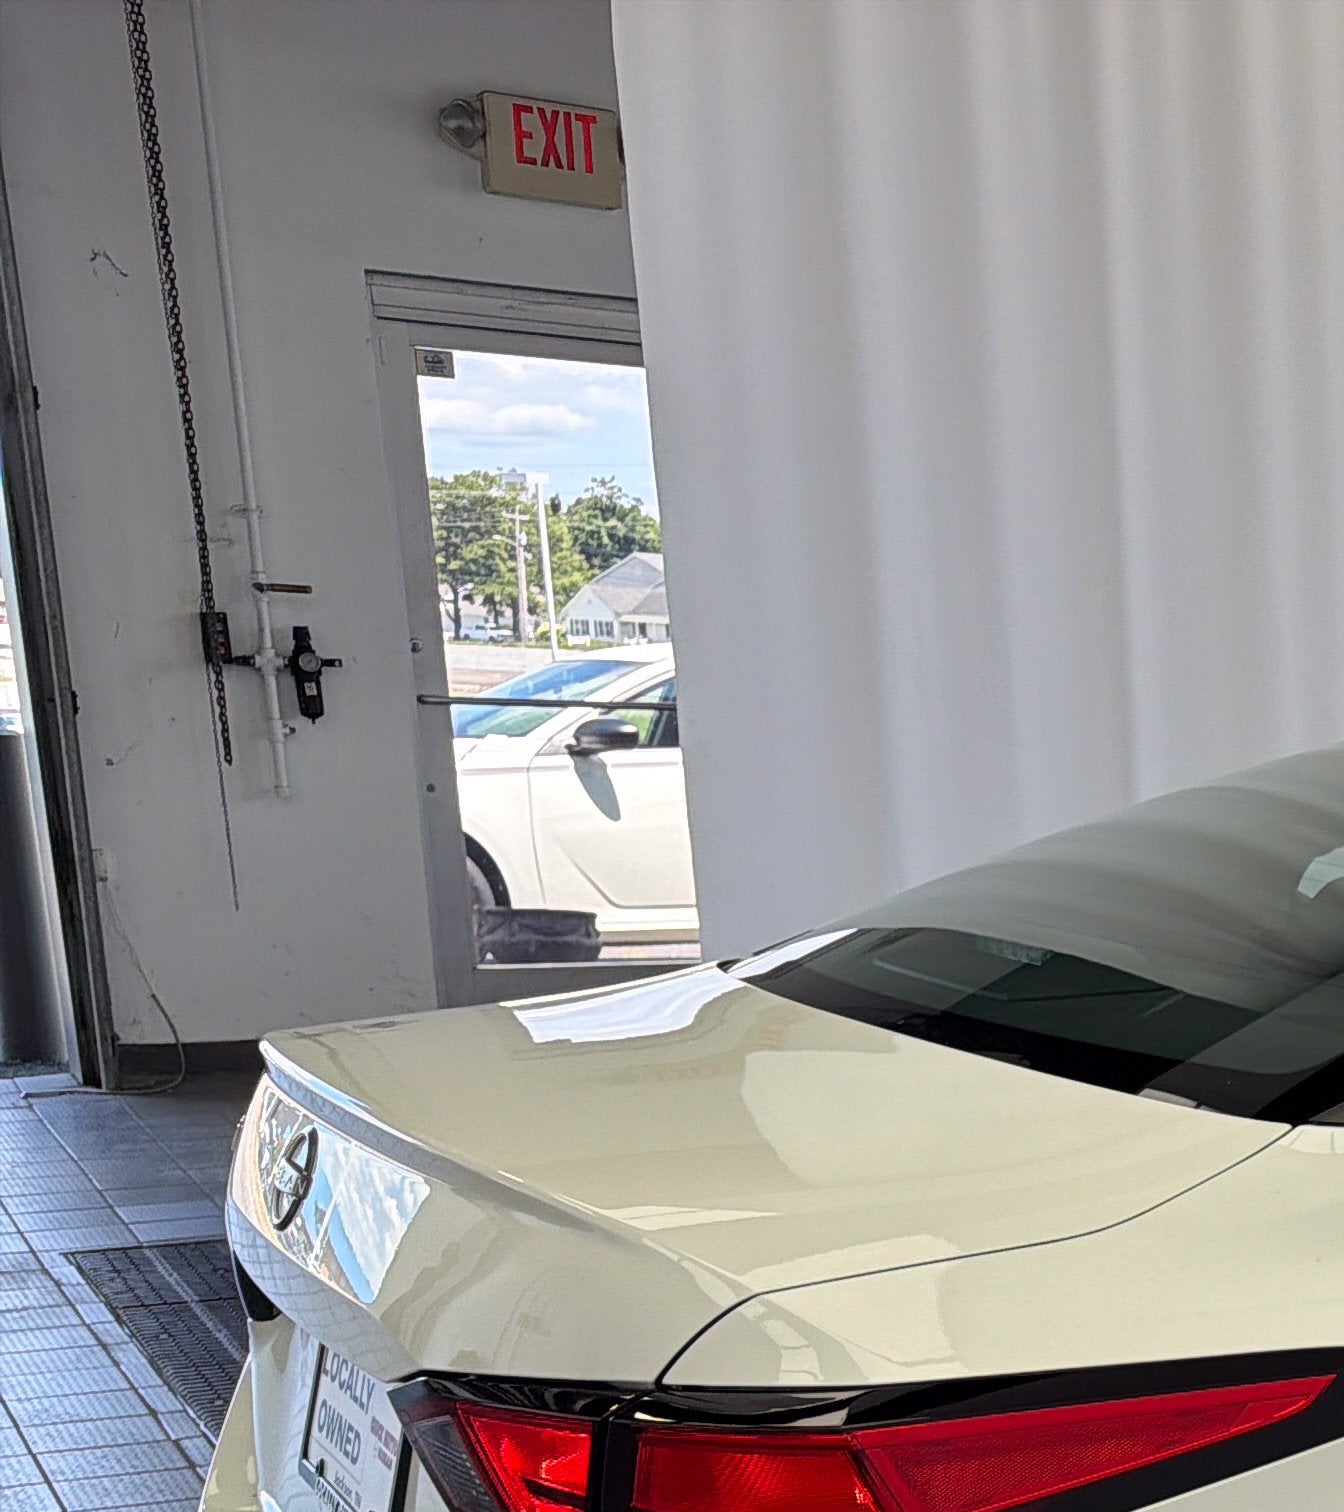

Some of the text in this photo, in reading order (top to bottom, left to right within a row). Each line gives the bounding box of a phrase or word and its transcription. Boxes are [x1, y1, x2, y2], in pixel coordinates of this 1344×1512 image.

[512, 103, 598, 174] EXIT
[322, 1346, 375, 1415] LOCALLY
[317, 1398, 362, 1466] OWNED
